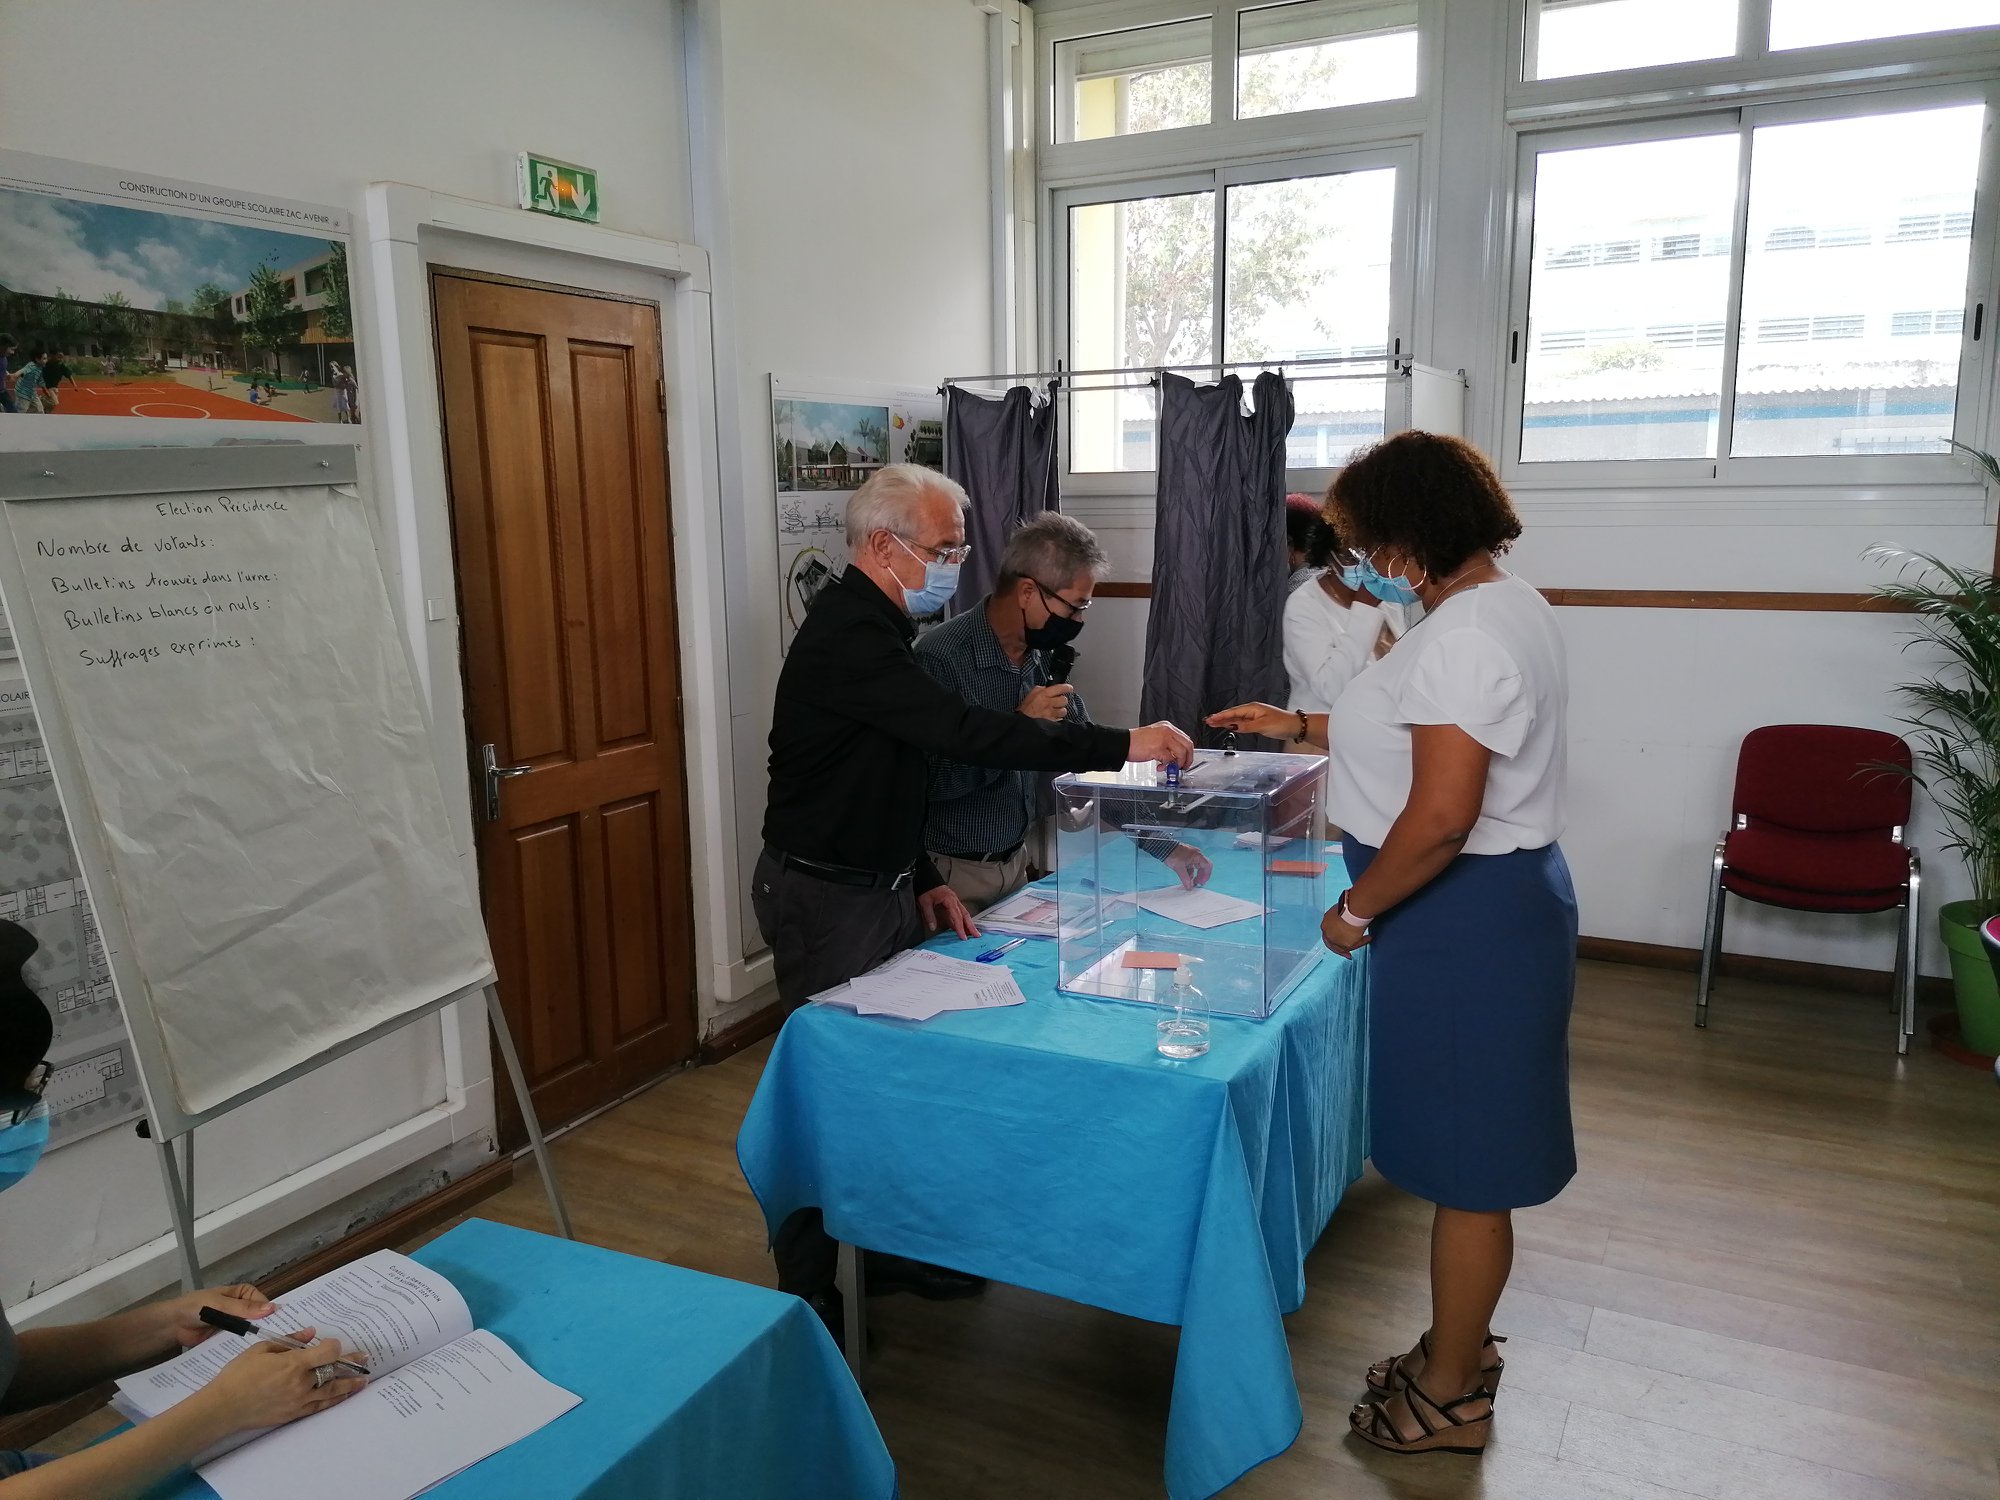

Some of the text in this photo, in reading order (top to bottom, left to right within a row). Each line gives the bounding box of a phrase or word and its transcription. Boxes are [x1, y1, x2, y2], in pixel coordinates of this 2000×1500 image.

[119, 180, 330, 224] CONSTRUCTION D'UN GROUPE SCOLAIRE ZAC AVENIR
[156, 501, 214, 517] Election
[36, 537, 111, 557] Nombre
[120, 536, 144, 553] de
[51, 576, 136, 594] Bulletins
[144, 571, 198, 588] trouvés
[202, 570, 232, 583] dans
[63, 606, 143, 630] Bulletins
[148, 603, 199, 619] blancs
[203, 604, 224, 615] ou
[229, 596, 260, 612] nuls
[79, 645, 160, 668] Suffrages
[170, 635, 241, 656] exprimés
